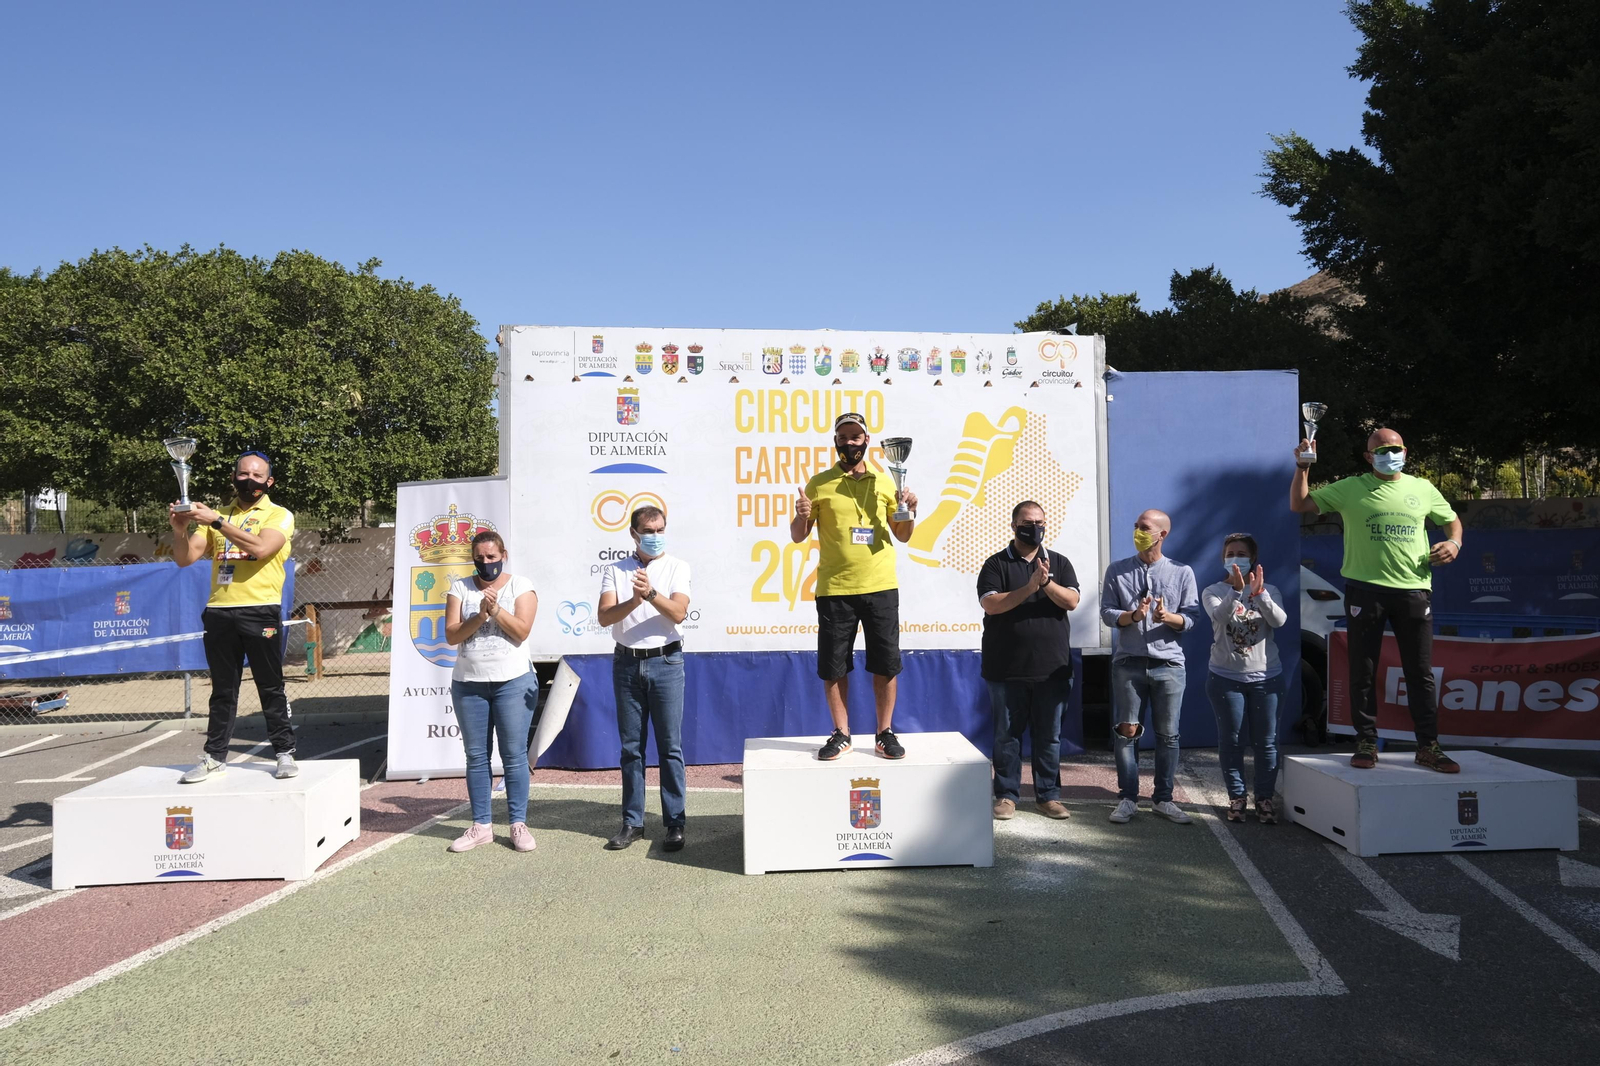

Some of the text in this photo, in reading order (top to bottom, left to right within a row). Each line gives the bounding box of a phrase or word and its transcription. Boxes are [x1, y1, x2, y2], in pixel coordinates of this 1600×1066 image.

[1042, 370, 1073, 378] circuitos
[735, 389, 885, 434] CIRCUITO
[588, 430, 668, 443] DIPUTACIÓN
[590, 443, 667, 456] DE ALMERÍA
[735, 446, 885, 485] CARRES
[1469, 577, 1512, 585] DIPUTACIÓN
[1557, 574, 1599, 582] DIPUTACIÓN
[1569, 581, 1599, 590] ALMERÍA
[93, 618, 150, 629] DIPUTACIÓN
[110, 628, 148, 637] ALMERÍA
[1470, 661, 1600, 675] SPORT & SHOES
[1450, 827, 1487, 835] DIPUTACIÓN
[836, 831, 893, 841] DIPUTACIÓN
[852, 841, 892, 850] ALMERÍA
[154, 852, 205, 862] DIPUTACIÓN
[169, 861, 204, 869] ALMERÍA
